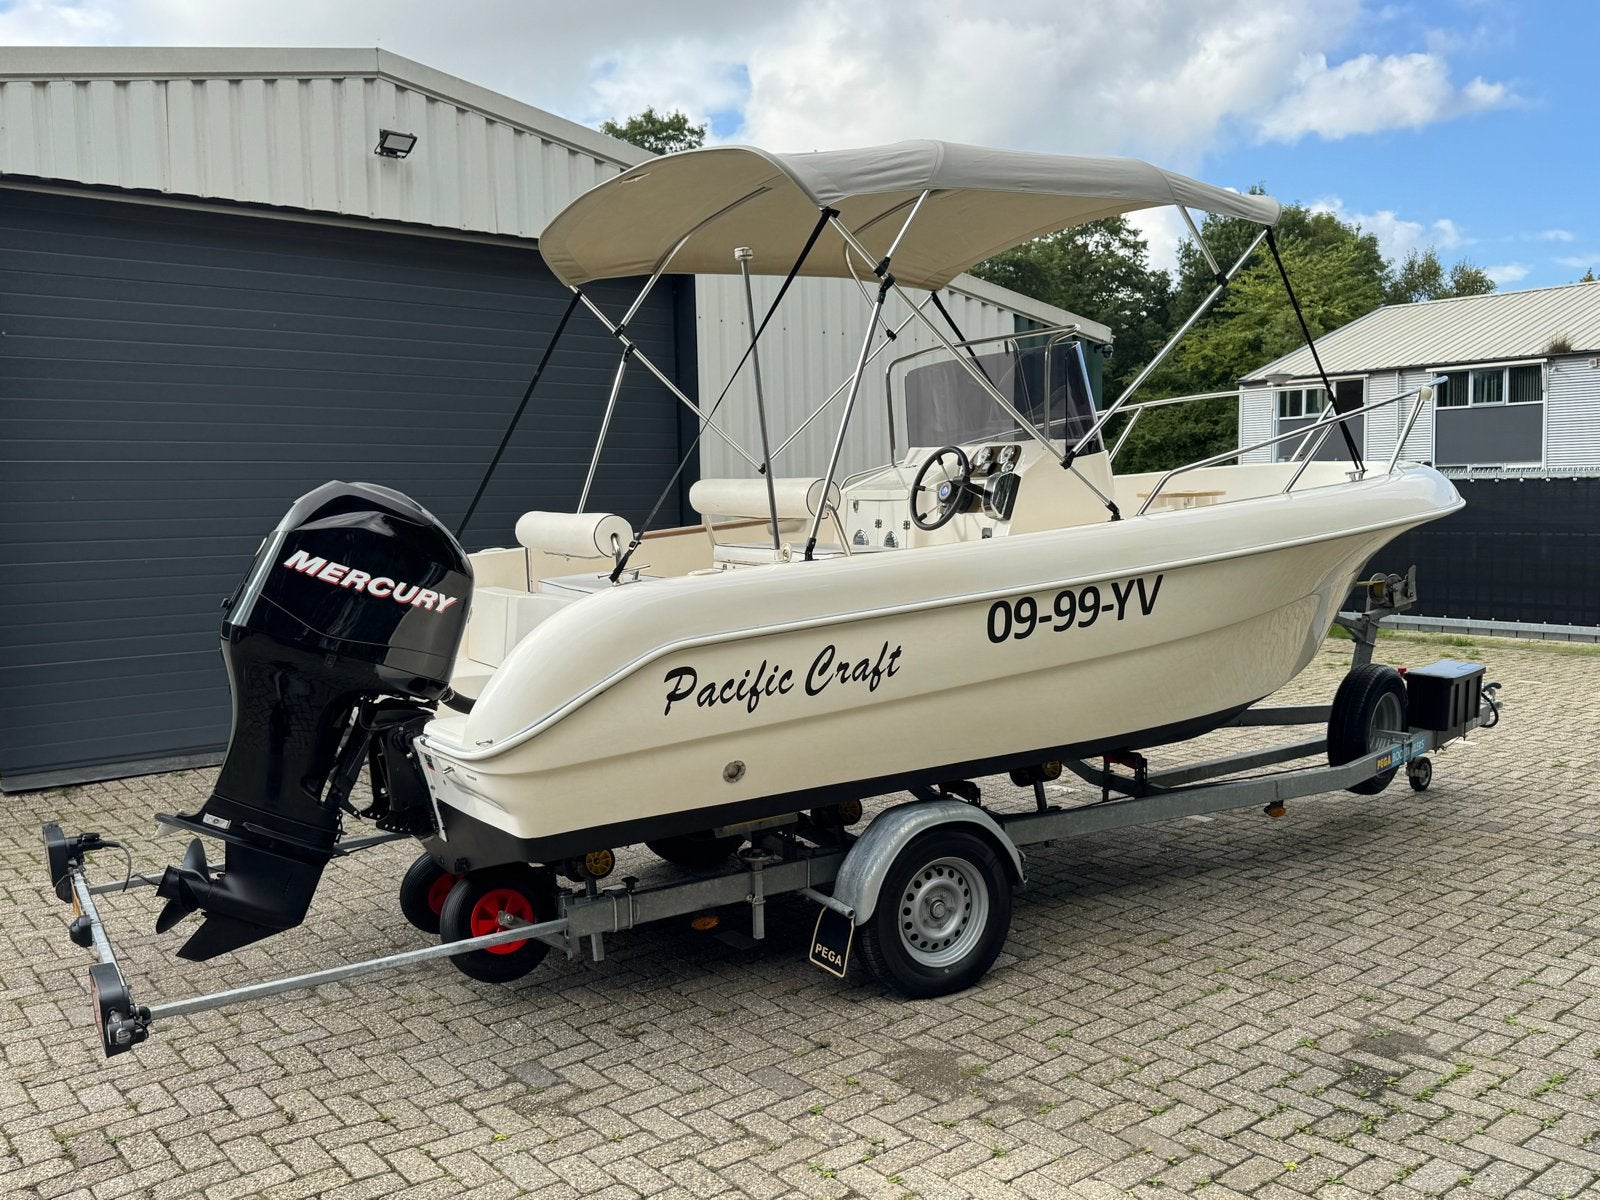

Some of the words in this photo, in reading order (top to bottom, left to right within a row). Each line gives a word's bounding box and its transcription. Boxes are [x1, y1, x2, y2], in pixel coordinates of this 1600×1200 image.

[283, 549, 458, 614] MERCURY
[987, 574, 1165, 643] 09-99-YV
[664, 659, 794, 716] Pacific
[805, 642, 902, 697] Craft
[814, 943, 842, 967] PEGA
